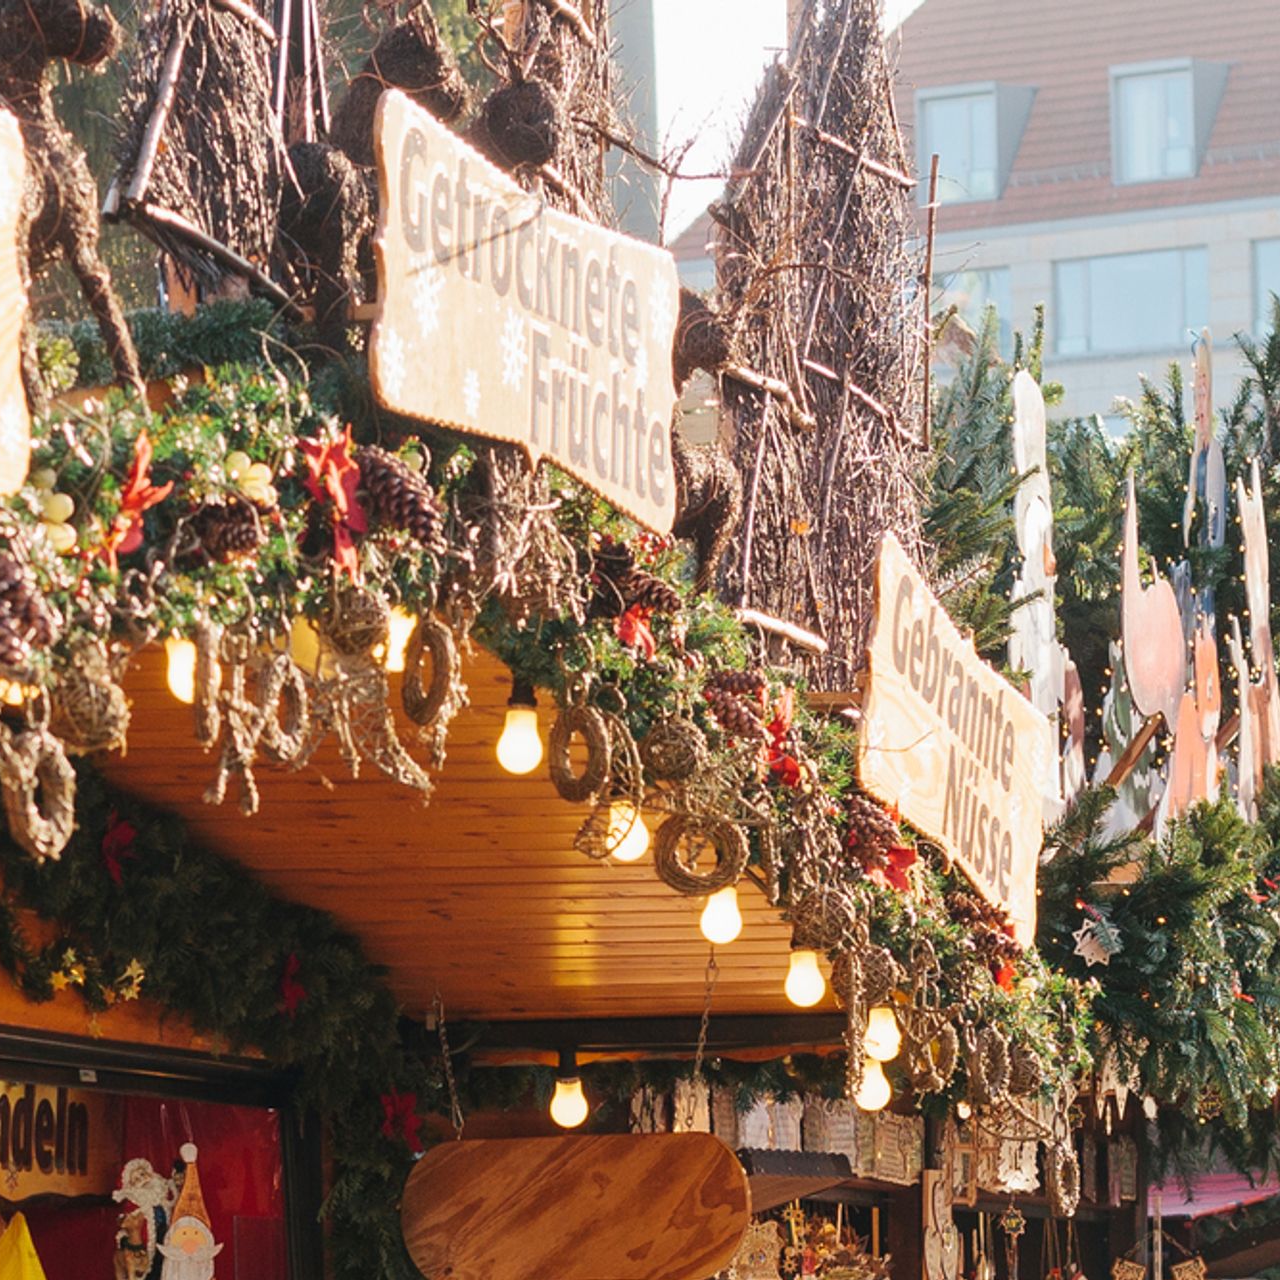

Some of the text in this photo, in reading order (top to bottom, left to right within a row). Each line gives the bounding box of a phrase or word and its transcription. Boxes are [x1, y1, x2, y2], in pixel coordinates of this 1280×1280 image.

[400, 127, 642, 367] Getrocknete
[530, 328, 666, 506] Früchte
[892, 574, 1015, 792] Gebrannte
[943, 745, 1013, 899] Nüsse
